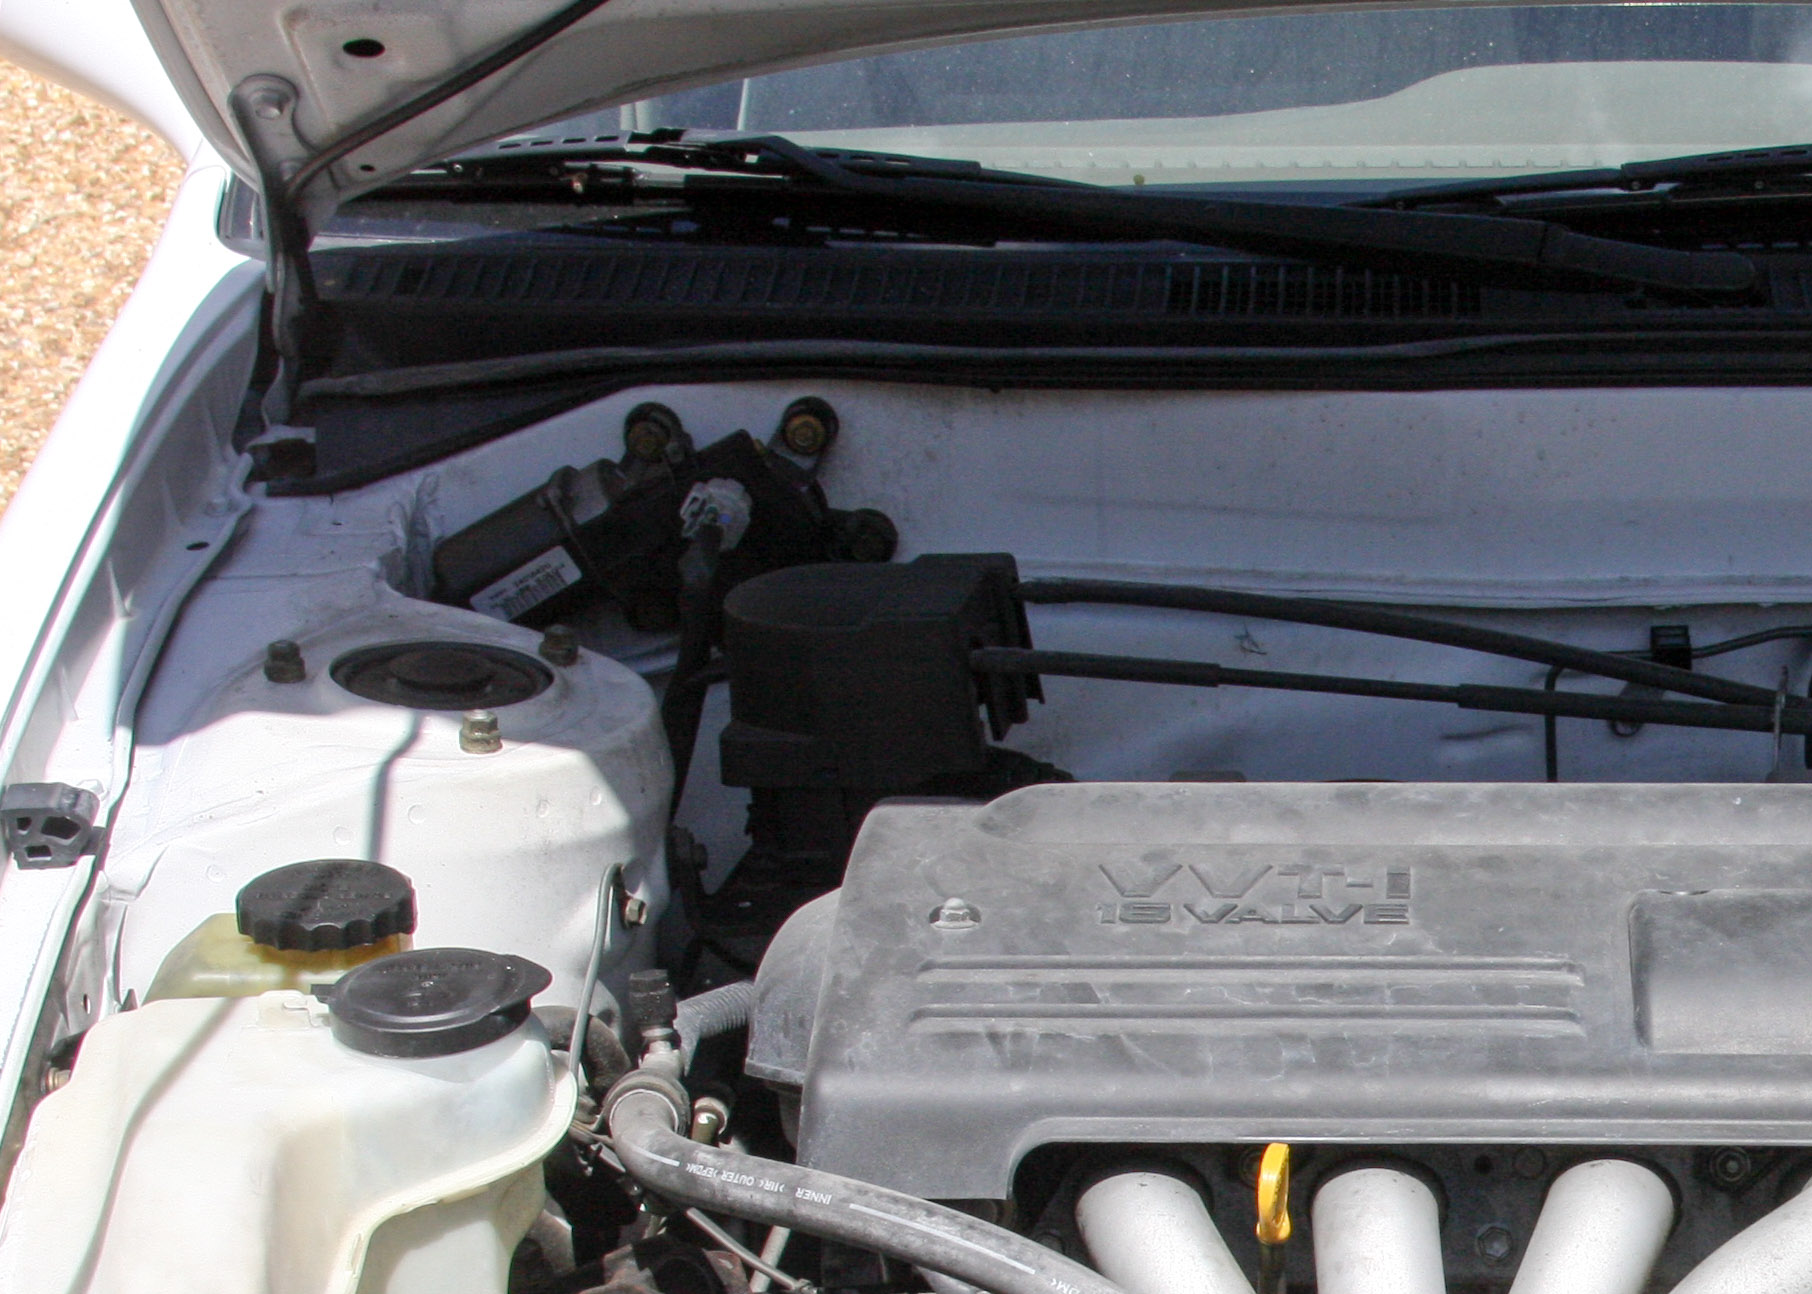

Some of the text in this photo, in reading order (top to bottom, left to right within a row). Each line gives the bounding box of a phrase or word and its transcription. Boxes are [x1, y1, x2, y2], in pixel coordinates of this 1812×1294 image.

[1183, 902, 1410, 924] VALVE
[721, 1169, 755, 1187] OUTER
[795, 1187, 833, 1206] INNER
